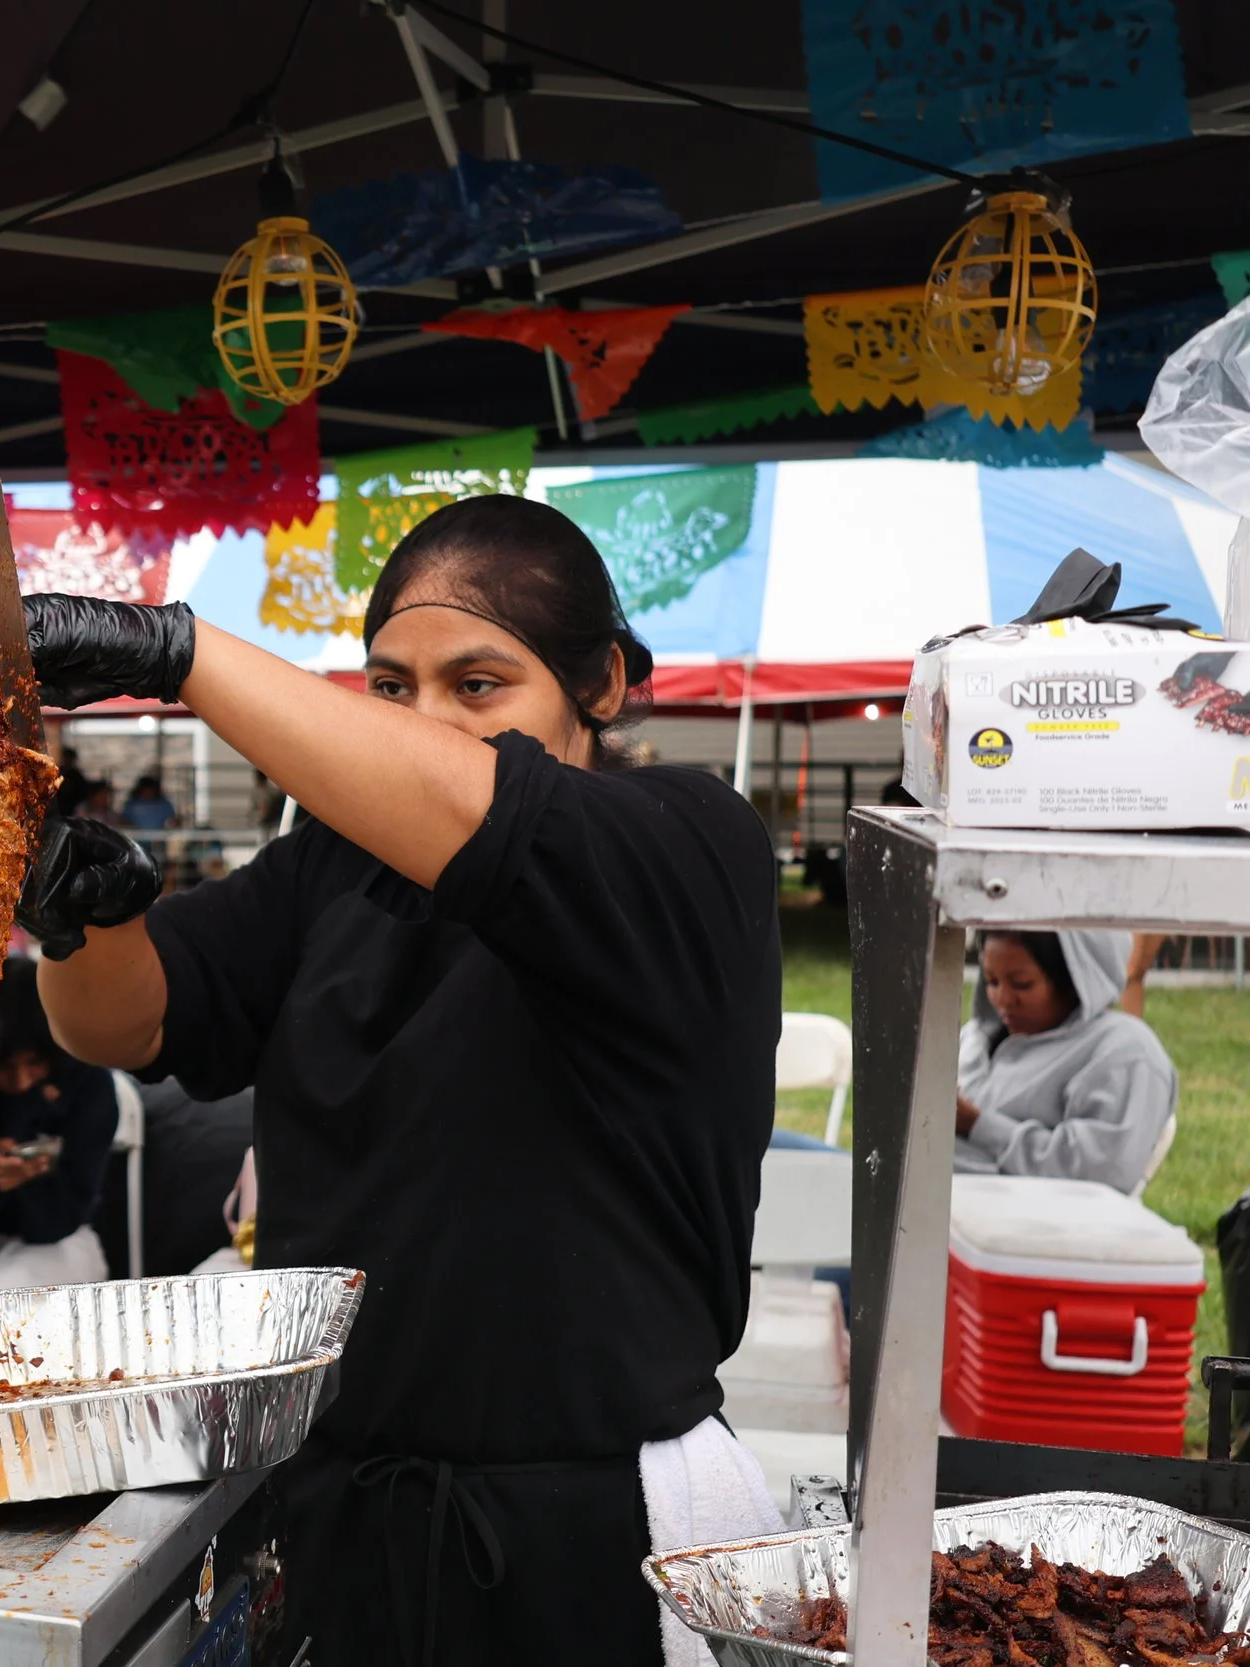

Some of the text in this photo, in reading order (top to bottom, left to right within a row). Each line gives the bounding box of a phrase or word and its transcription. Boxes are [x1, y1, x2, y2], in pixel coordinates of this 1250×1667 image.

[1011, 679, 1134, 707] NITRILE
[1038, 708, 1107, 720] GLOVES
[1056, 787, 1080, 795] Black
[1083, 787, 1108, 795] Nitrile
[1140, 795, 1168, 804] Negro
